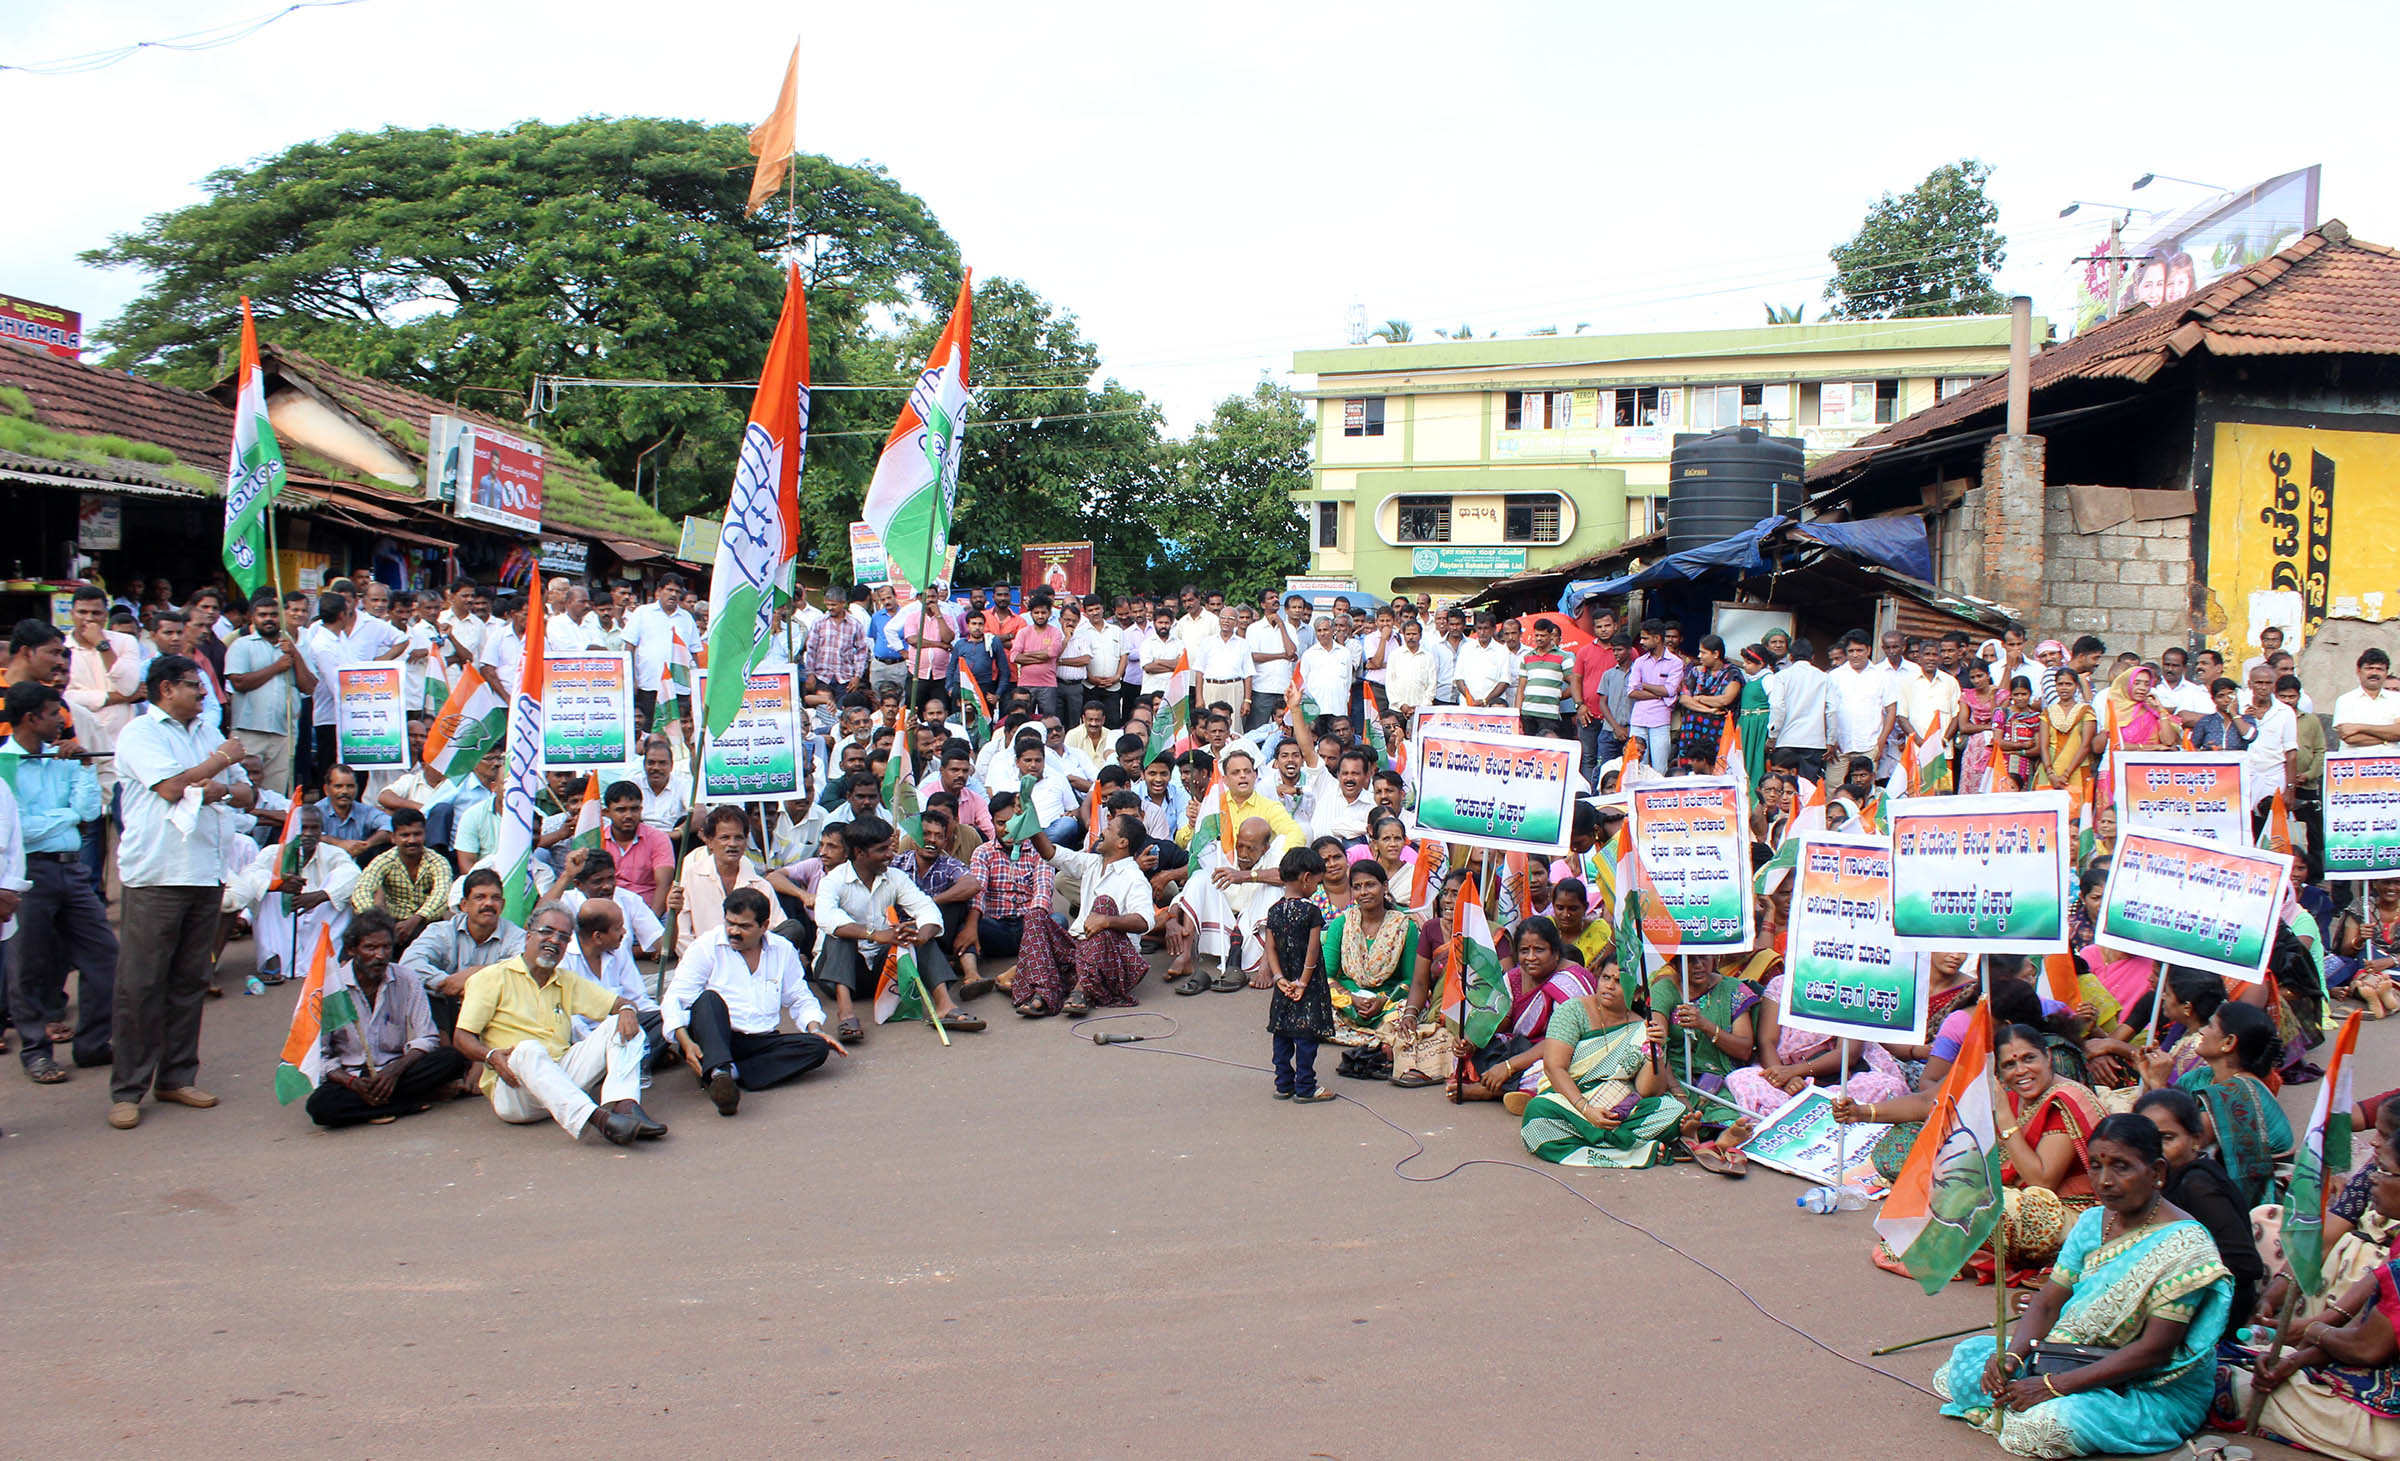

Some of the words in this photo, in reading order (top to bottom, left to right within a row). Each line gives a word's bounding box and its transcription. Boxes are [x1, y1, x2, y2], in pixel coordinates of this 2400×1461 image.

[1429, 751, 1443, 769] ಜನ
[1447, 750, 1481, 777] ವಿರೋಧಿ
[1485, 752, 1511, 785] ಕೇಂದ್ರ
[2147, 770, 2171, 792] ರೈತರ
[1646, 794, 1679, 810] ಕರ್ನಾಟಕ
[1683, 792, 1722, 808] ಸರಕಾರದ
[1454, 793, 1495, 831] ಸರಕಾರಕ್ಕೆ
[1499, 800, 1526, 834] ಧಿಕ್ಕಾರ
[1693, 817, 1726, 831] ಸರಕಾರ
[1651, 845, 1669, 863] ರೈತರ
[1673, 846, 1691, 856] ಸಾಲ
[1696, 845, 1721, 861] ಮನ್ನಾ
[1900, 829, 1915, 856] ಜನ
[1919, 827, 1957, 859] ವಿರೋಧಿ
[1963, 826, 1992, 866] ಕೇಂದ್ರ
[1690, 867, 1729, 881] ಇದೊಂದು
[1811, 852, 1840, 883] ಮಹಾತ್ಮ
[1690, 894, 1709, 905] ಎಂದ
[1930, 884, 1976, 931] ಸರಕಾರಕ್ಕೆ
[1981, 888, 2013, 932] ಧಿಕ್ಕಾರ
[1711, 916, 1738, 936] ಧಿಕ್ಕಾರ
[1813, 940, 1854, 961] ಅವಹೇಳನ
[1858, 944, 1891, 965] ಮಾಡಿದ
[1807, 981, 1836, 1001] ಅಮಿತ್
[1868, 987, 1899, 1020] ಧಿಕ್ಕಾರ
